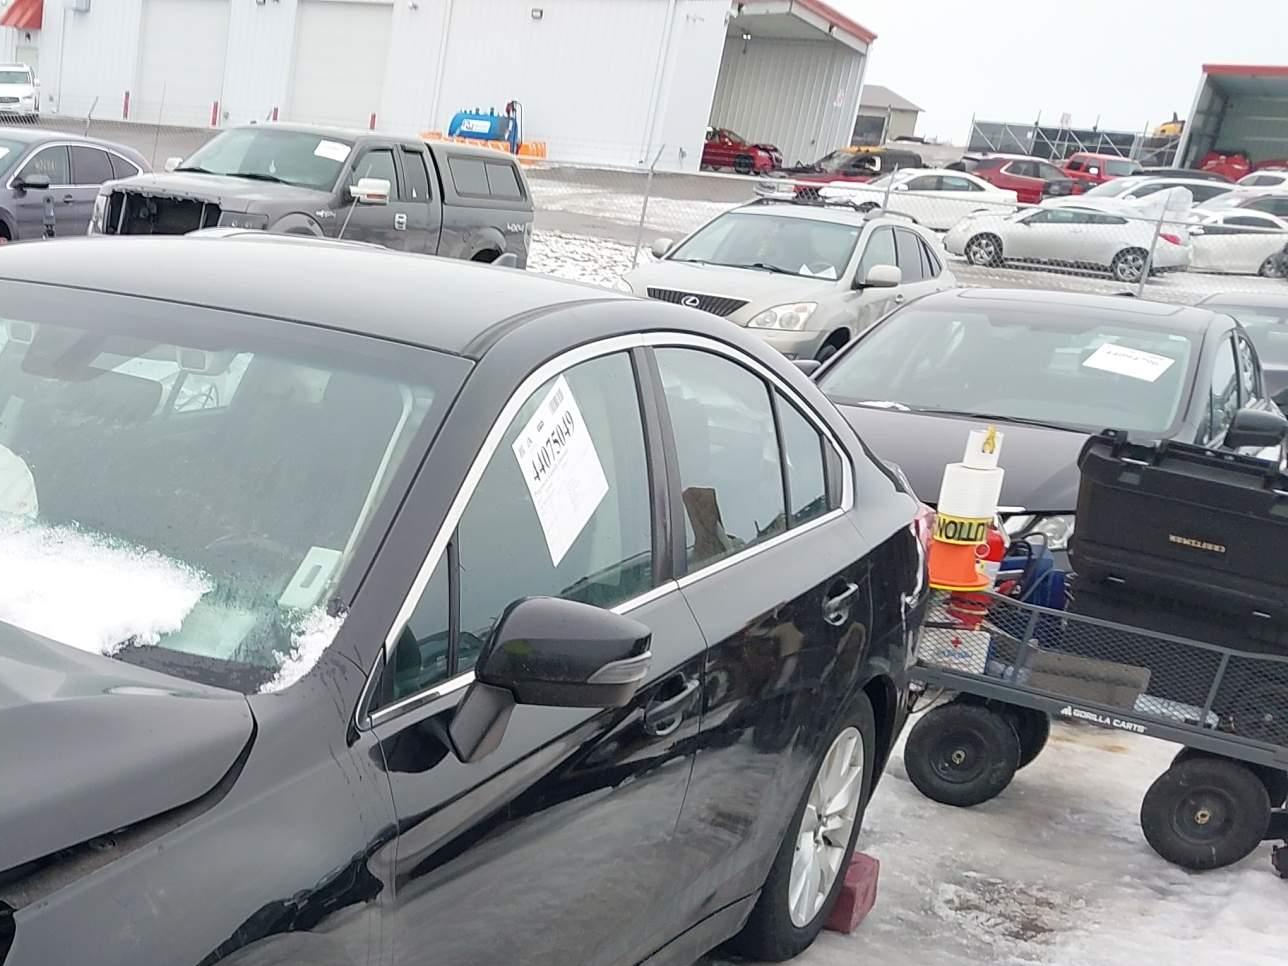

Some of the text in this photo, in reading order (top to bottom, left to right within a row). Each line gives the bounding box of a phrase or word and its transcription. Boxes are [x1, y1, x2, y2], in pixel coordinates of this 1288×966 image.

[531, 410, 575, 481] 44075049
[1072, 708, 1145, 734] GORILLA CARTS
